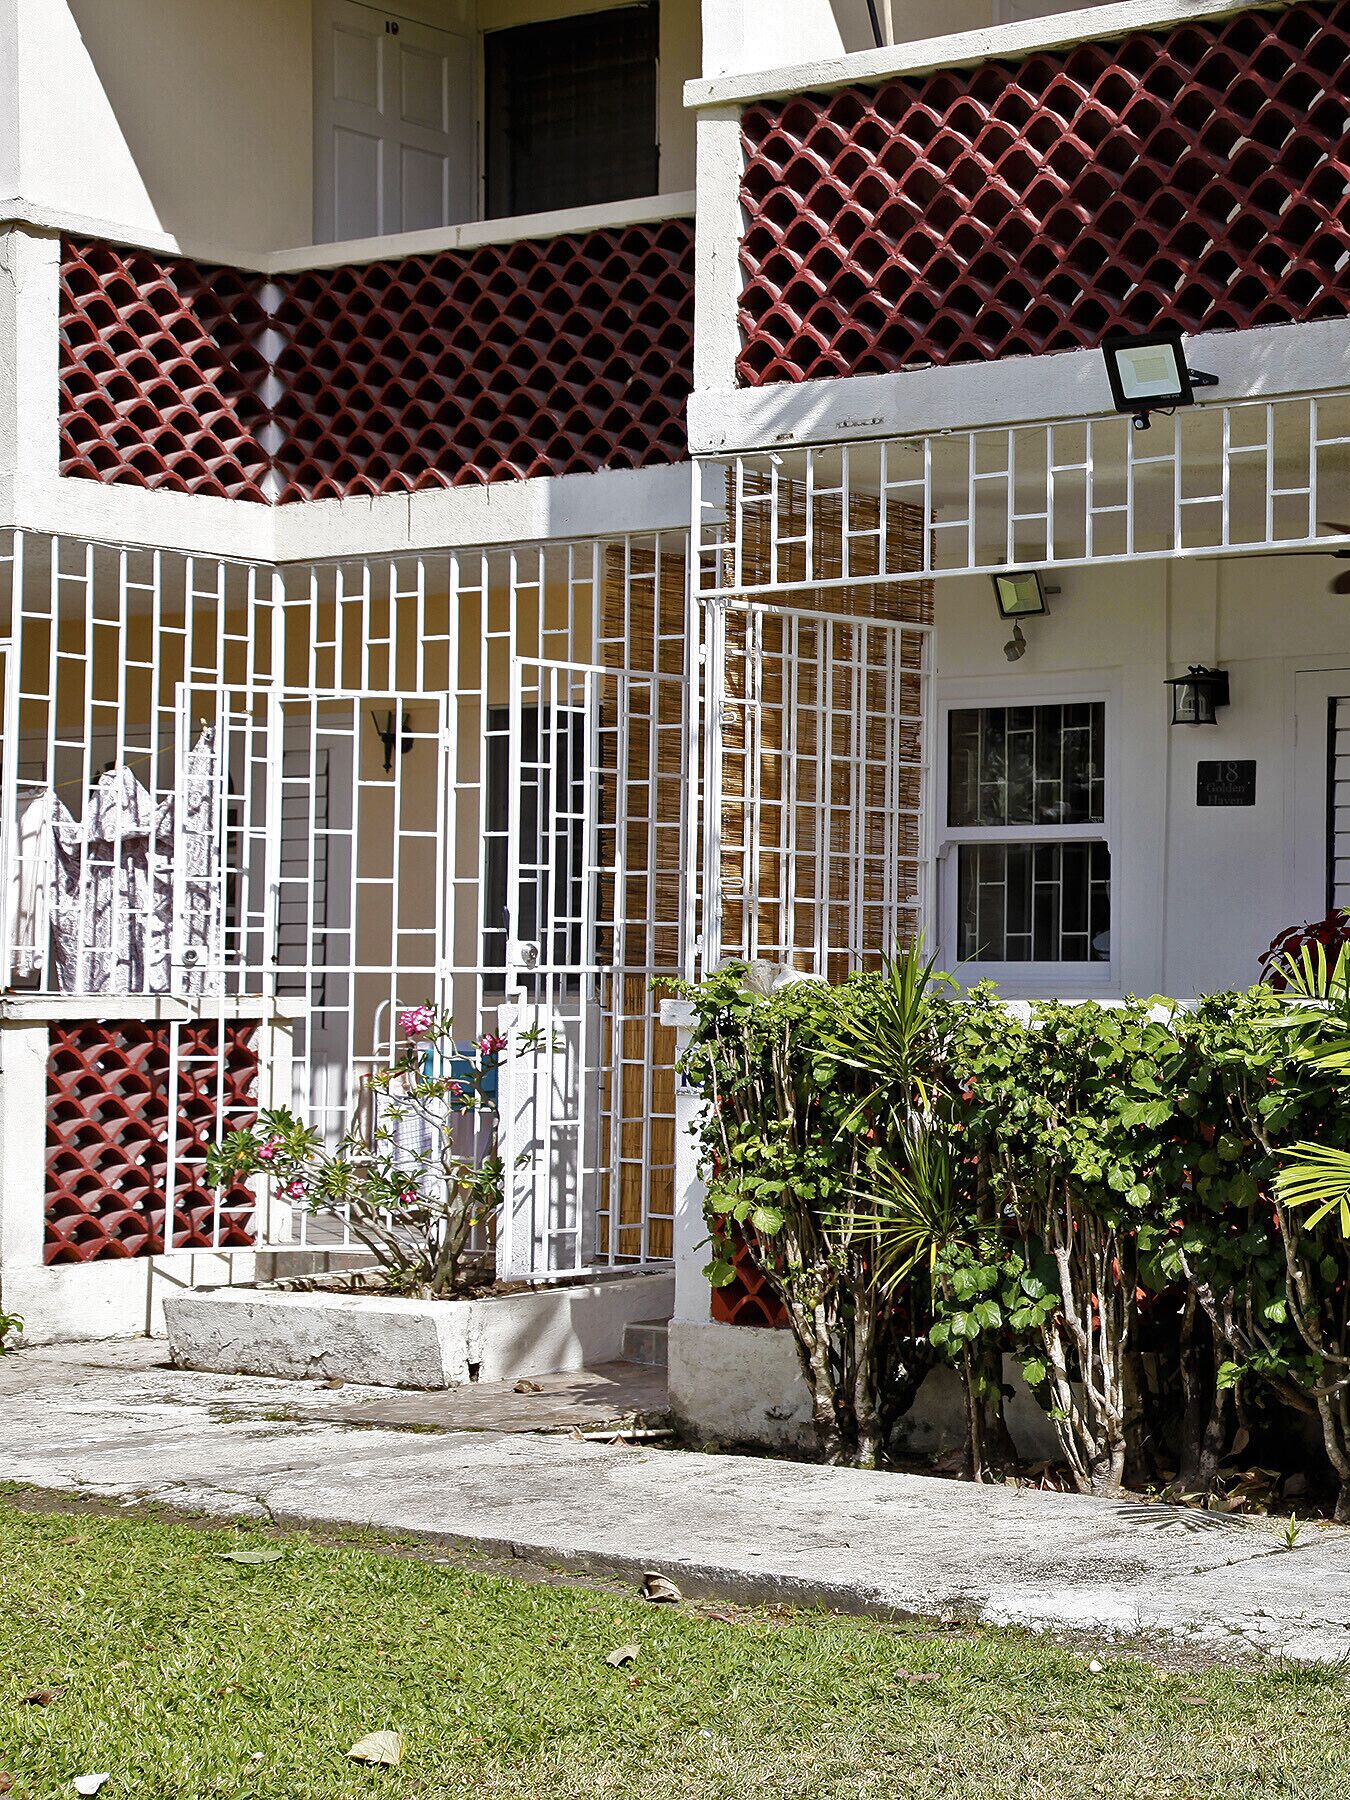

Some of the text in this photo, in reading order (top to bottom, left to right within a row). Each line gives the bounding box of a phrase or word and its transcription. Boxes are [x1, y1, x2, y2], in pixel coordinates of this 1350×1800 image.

[1215, 762, 1239, 782] 18
[1206, 783, 1247, 792] Golden
[1207, 795, 1243, 804] Haven
